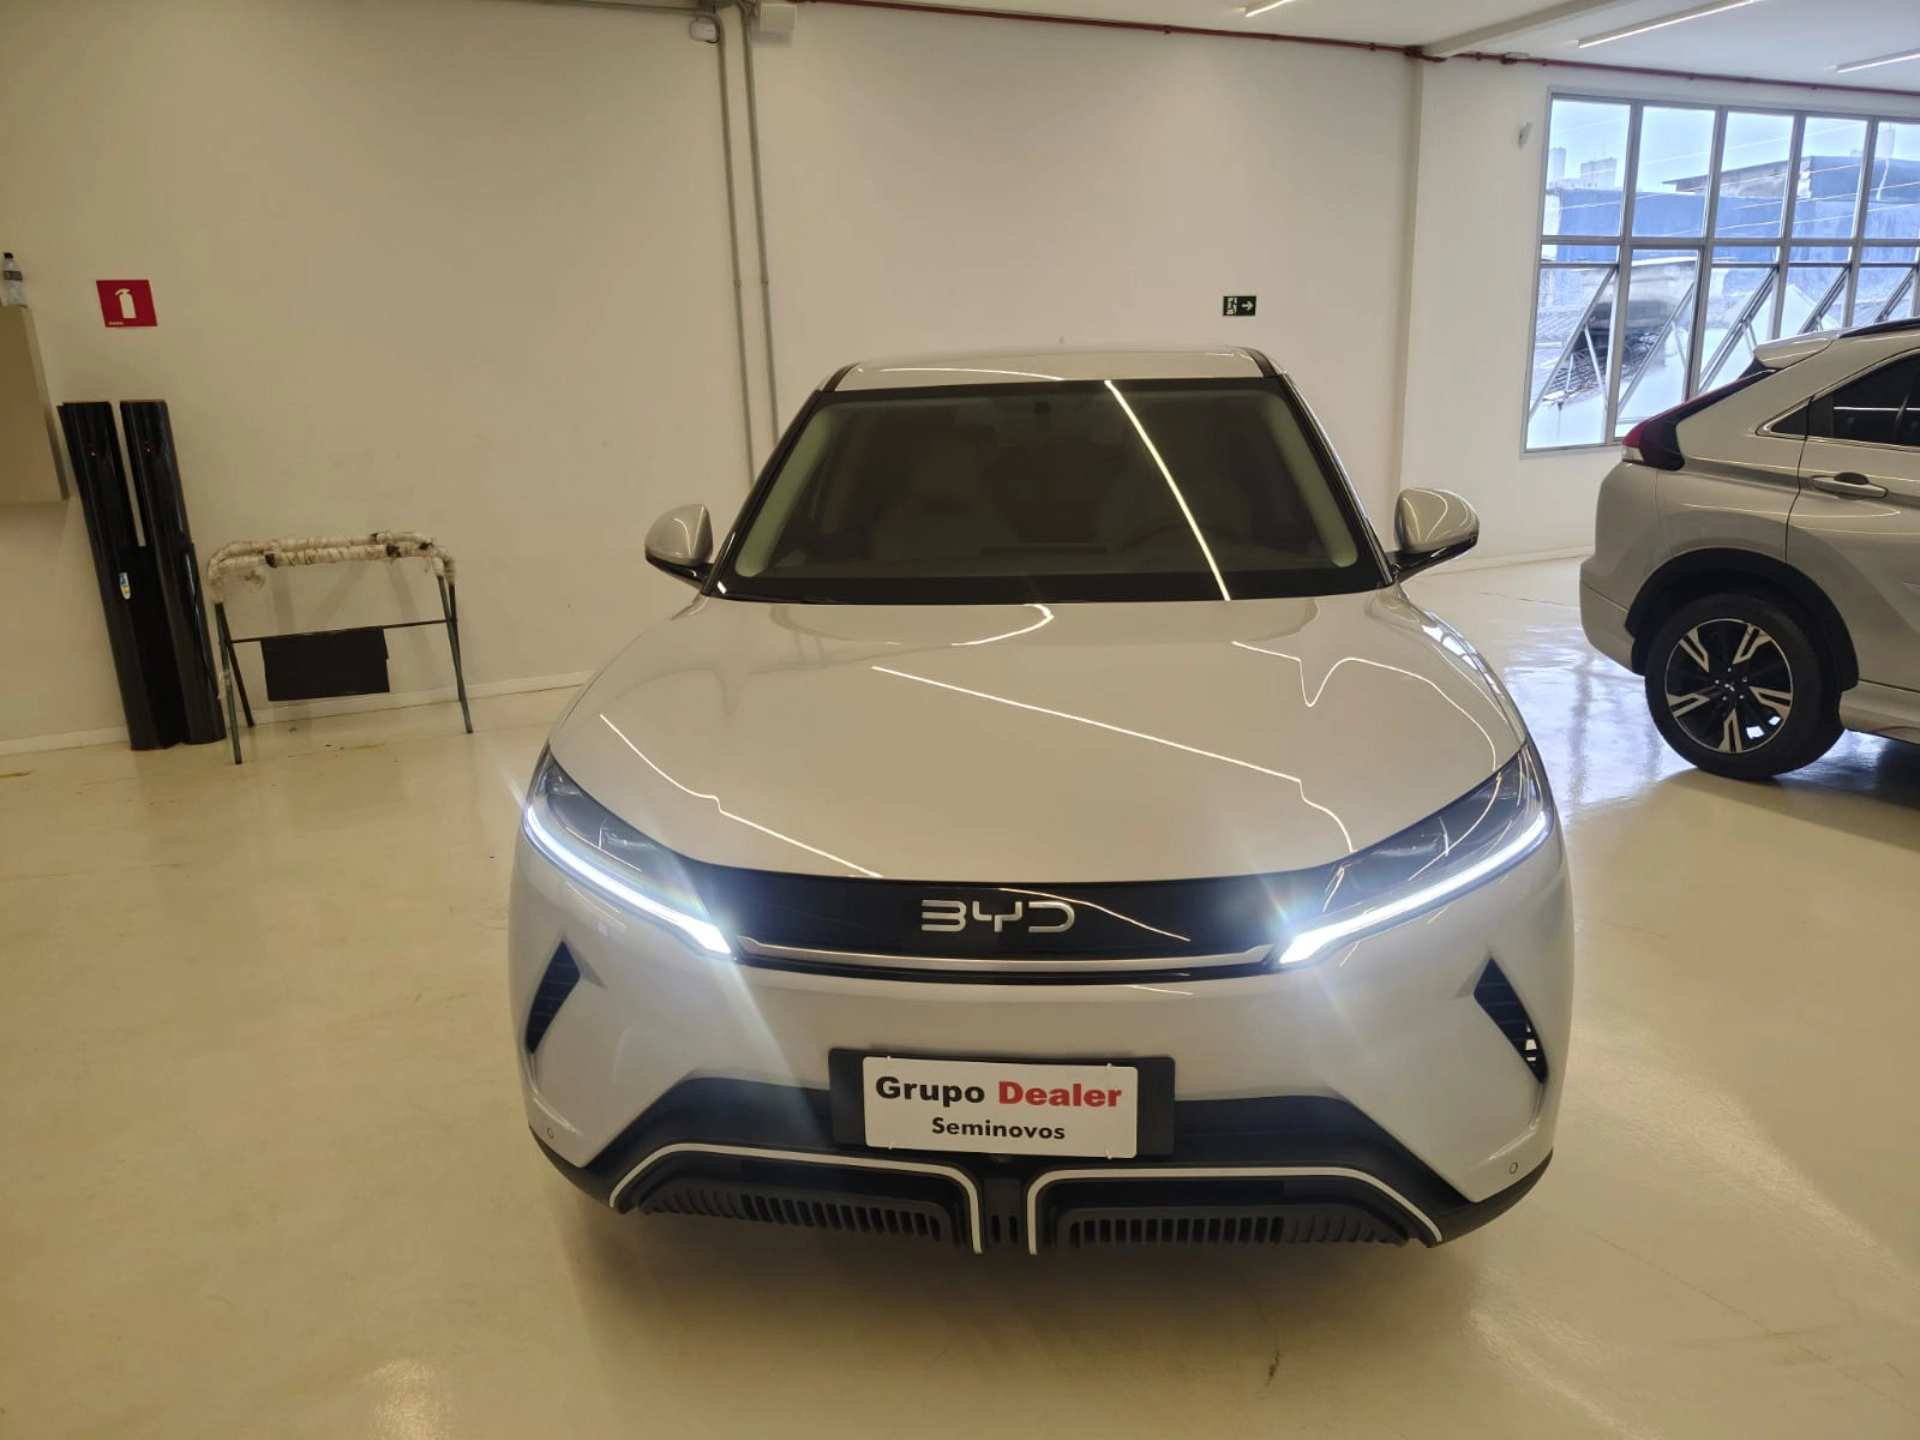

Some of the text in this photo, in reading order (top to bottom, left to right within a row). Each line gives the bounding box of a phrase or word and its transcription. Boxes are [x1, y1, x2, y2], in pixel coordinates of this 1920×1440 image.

[921, 899, 1075, 933] BYD
[875, 1075, 1122, 1108] Grupo Dealer
[931, 1116, 1066, 1140] Seminovos
